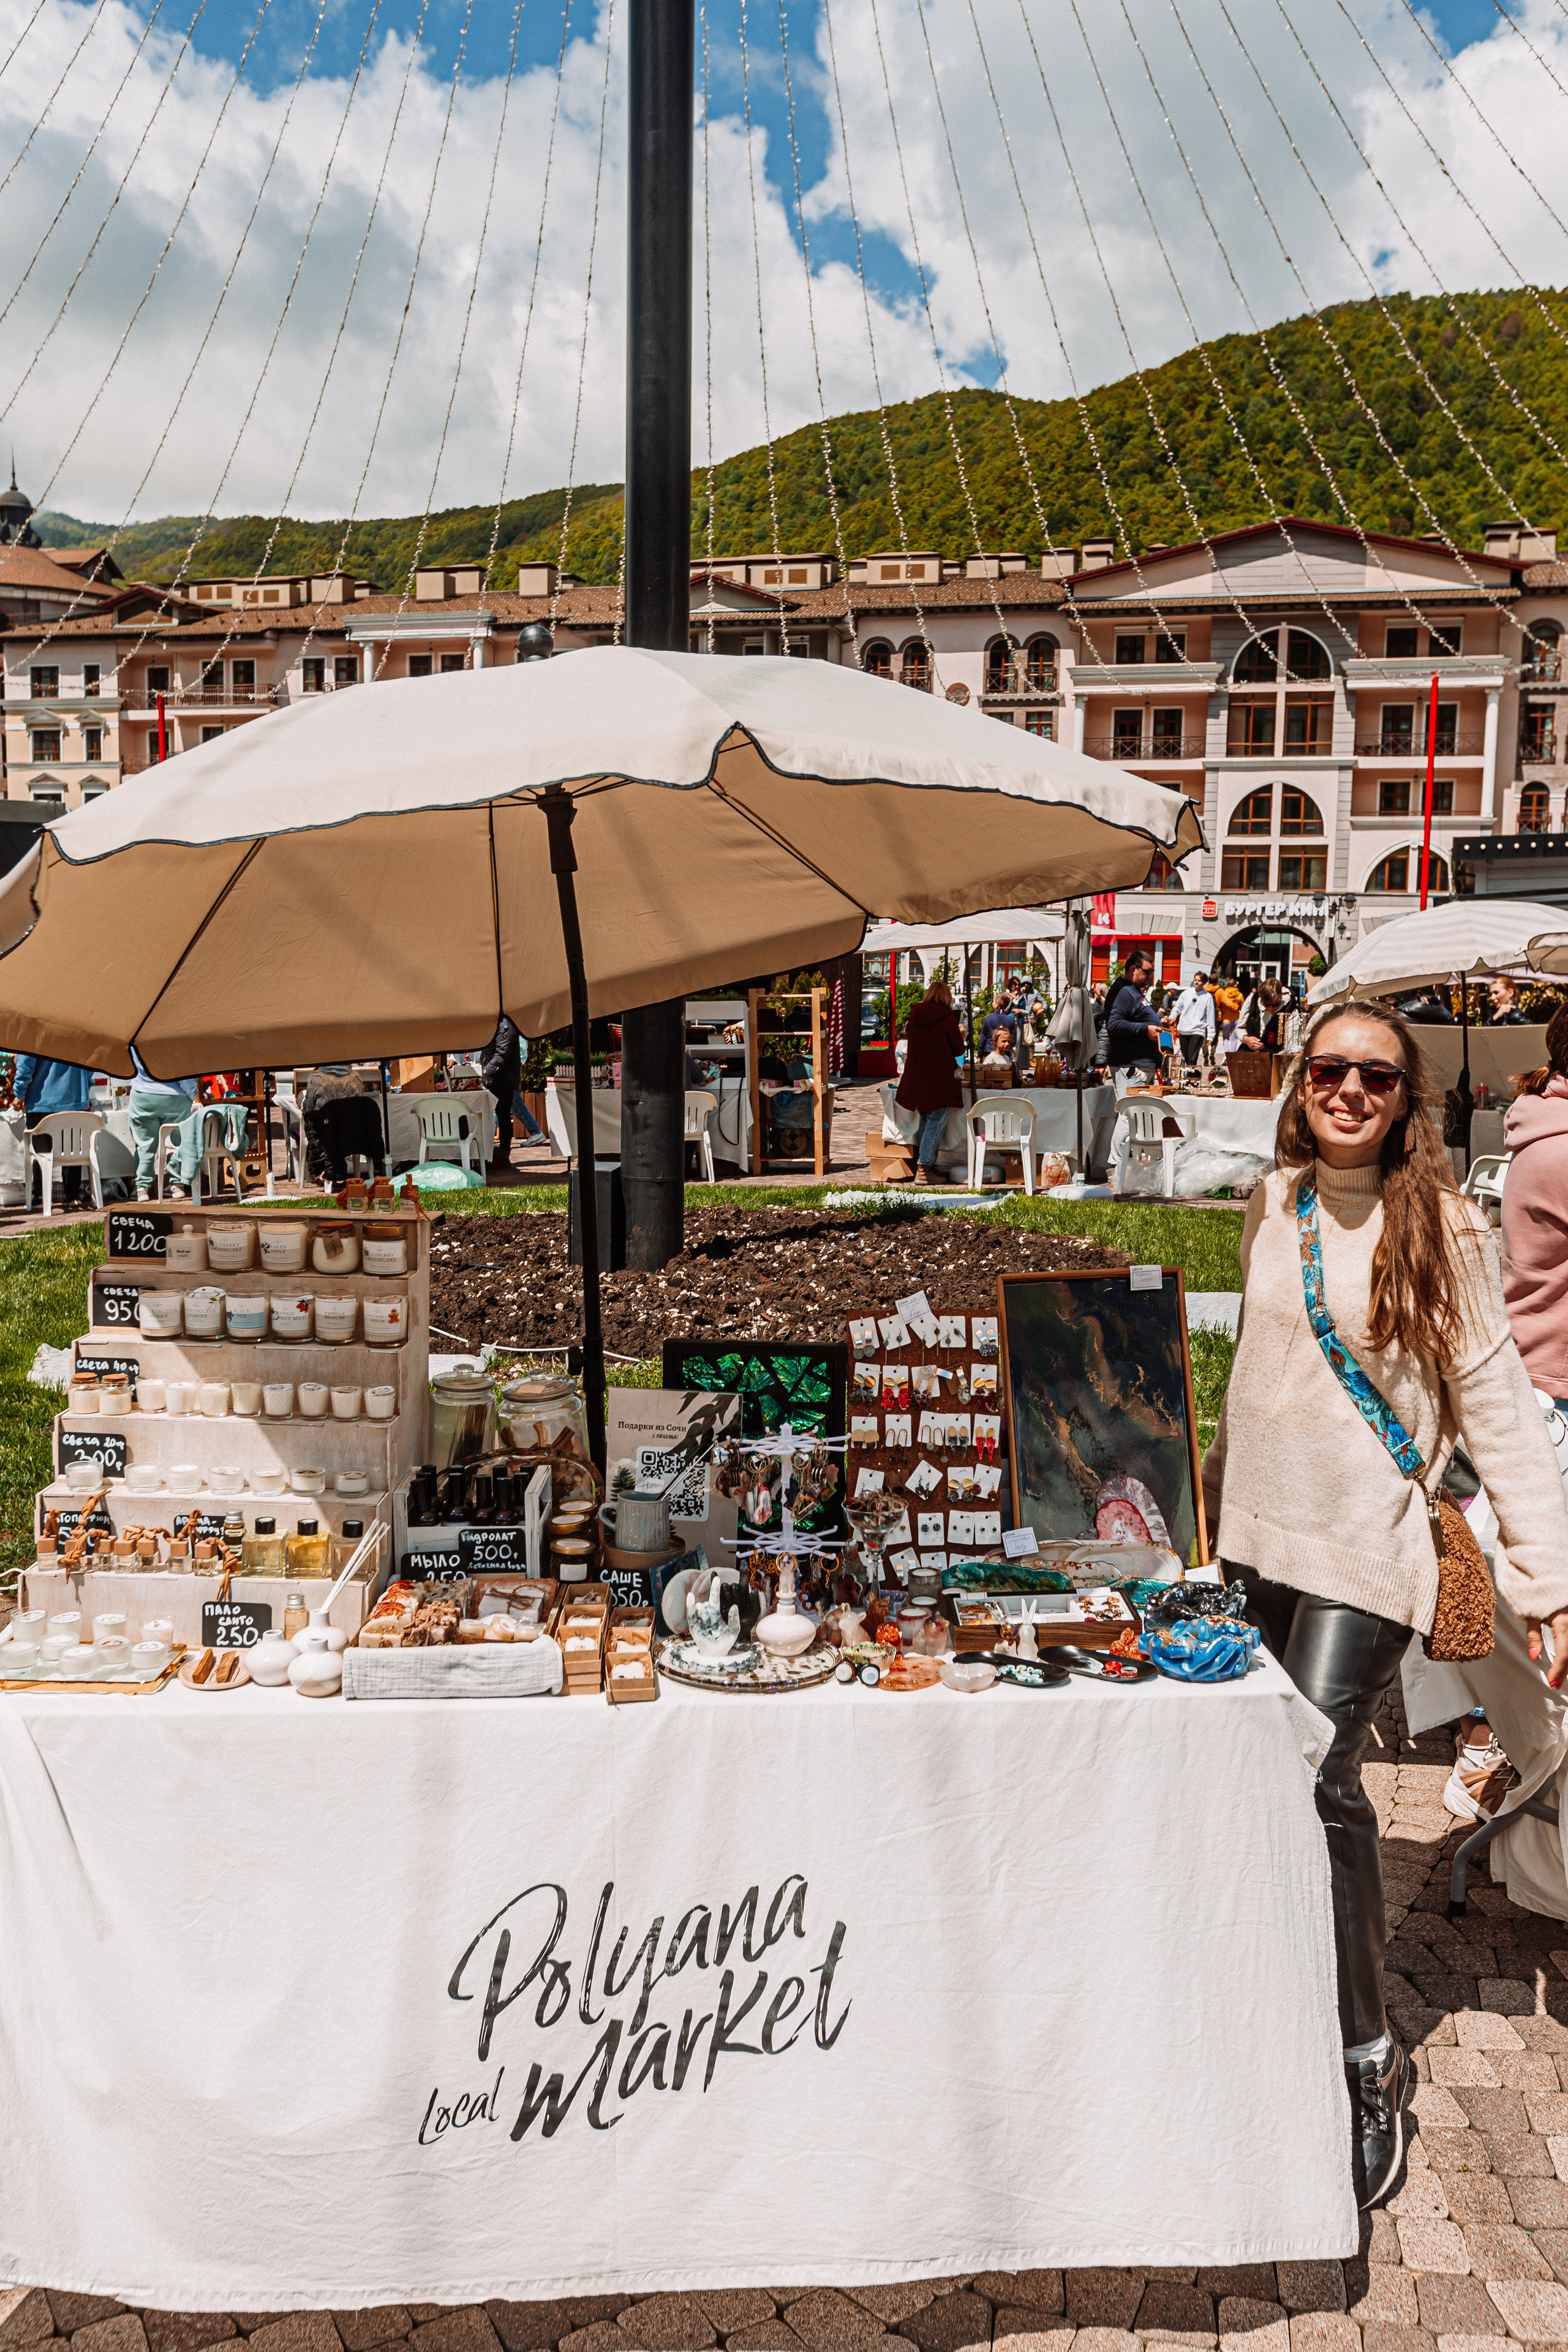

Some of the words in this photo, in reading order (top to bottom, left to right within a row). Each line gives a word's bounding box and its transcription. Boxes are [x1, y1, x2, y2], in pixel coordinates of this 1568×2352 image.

[1224, 902, 1286, 916] БУРГЕР
[111, 1216, 154, 1230] СВЕЧА
[114, 1231, 167, 1253] 1200
[618, 1421, 654, 1431] Подарки
[411, 1555, 460, 1569] МЫЛО
[600, 1569, 643, 1588] САШЕ
[205, 1604, 241, 1616] ПАЛО
[448, 1873, 809, 2062] Polyana
[418, 2065, 505, 2146] Local
